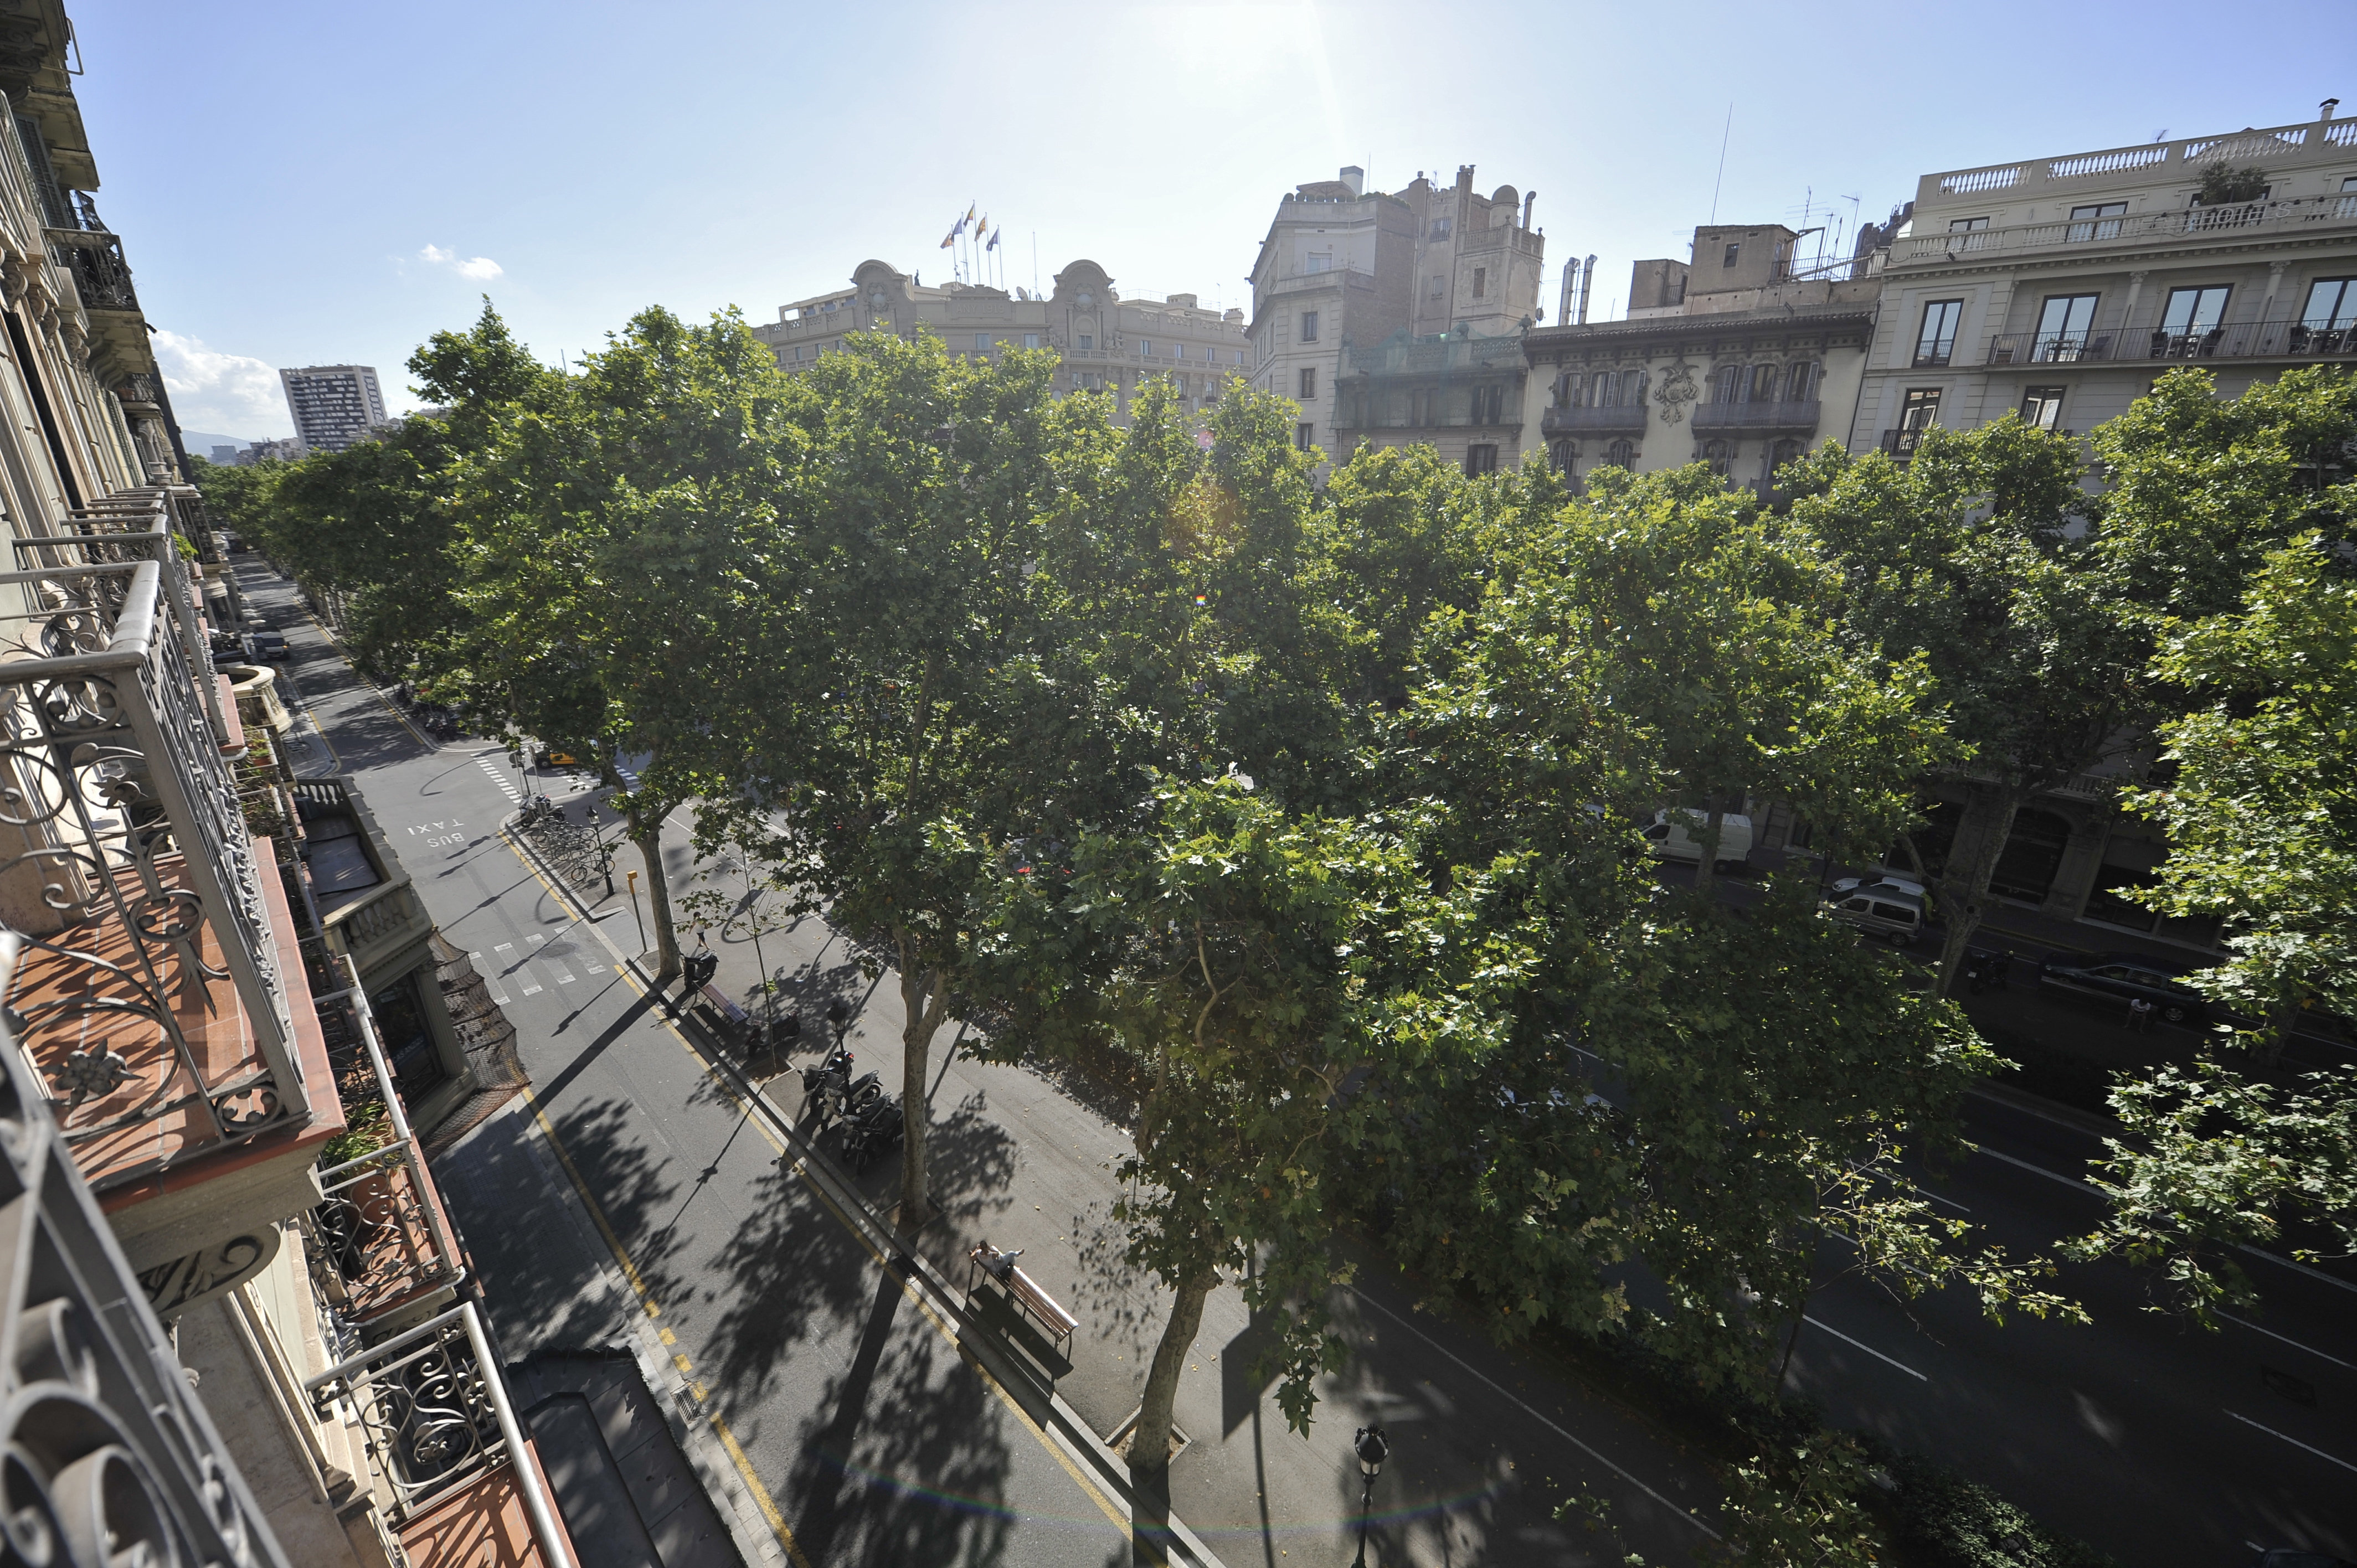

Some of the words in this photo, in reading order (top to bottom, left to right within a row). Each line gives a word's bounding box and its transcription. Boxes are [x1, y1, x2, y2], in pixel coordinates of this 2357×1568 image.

[957, 304, 976, 313] ANY
[982, 304, 1005, 313] 1919
[408, 819, 464, 835] TAXI
[427, 833, 465, 847] BUS
